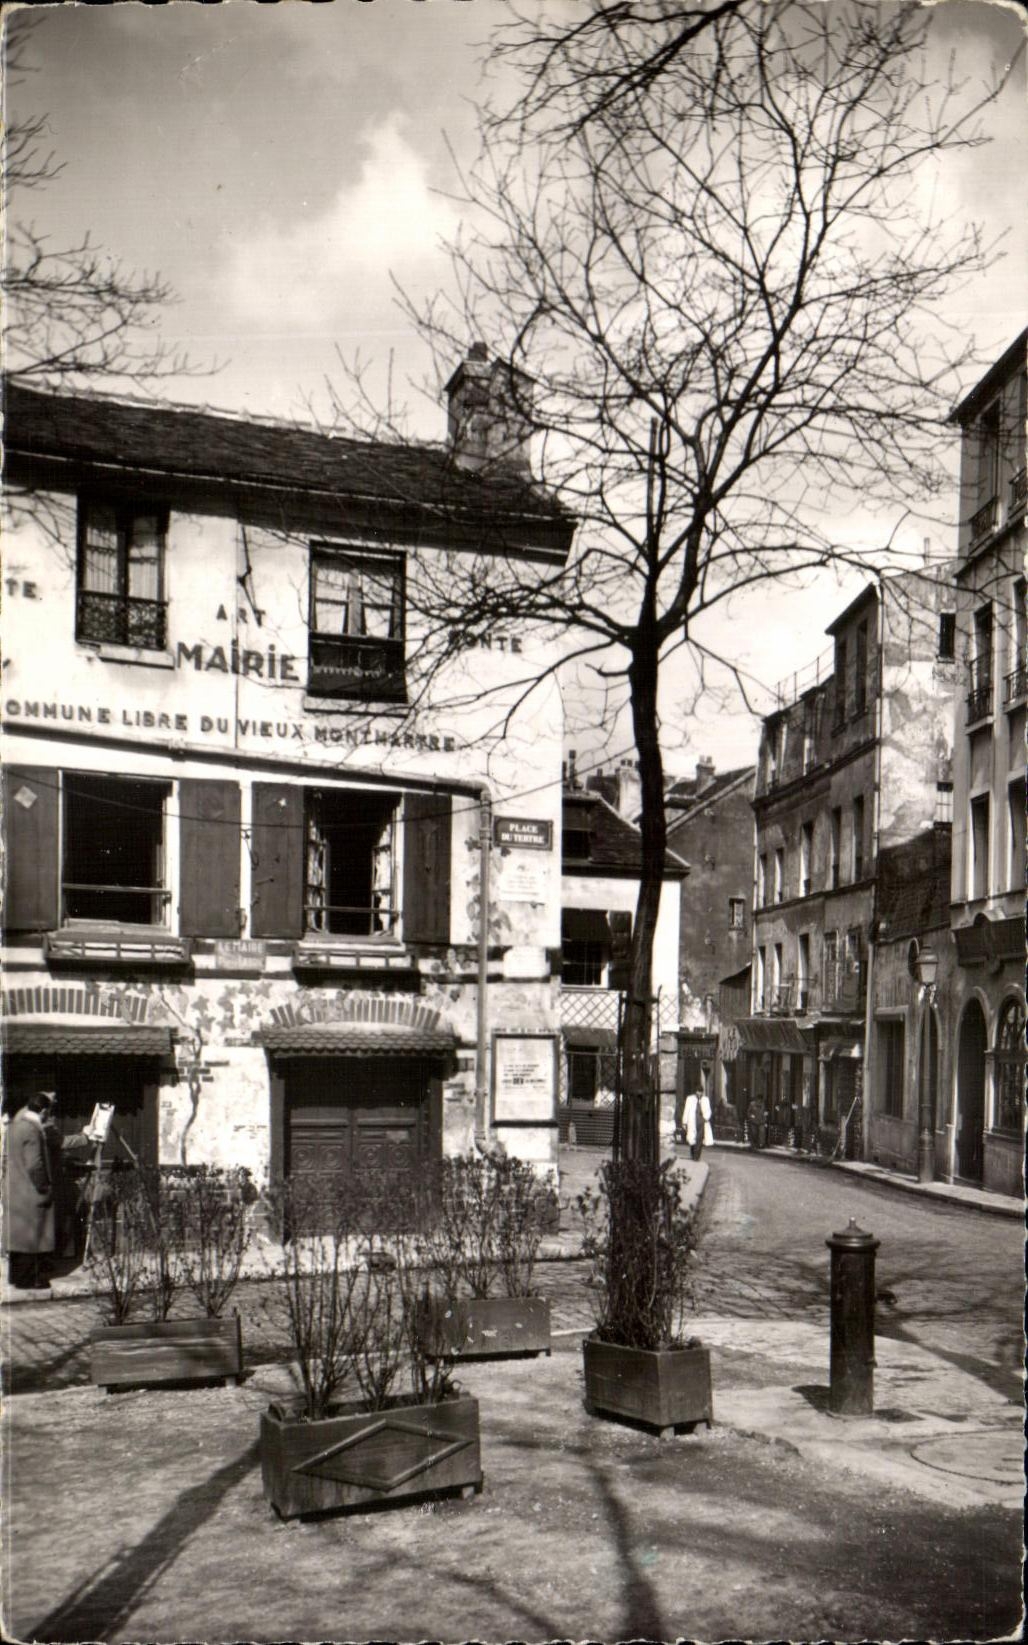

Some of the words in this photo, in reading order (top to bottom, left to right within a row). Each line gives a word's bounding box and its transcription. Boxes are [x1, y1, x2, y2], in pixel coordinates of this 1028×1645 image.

[216, 603, 266, 628] ART
[122, 709, 188, 731] LIBRE
[200, 715, 228, 734] DU
[238, 718, 303, 741] VIEUX
[509, 823, 538, 833] PLACE
[513, 834, 545, 844] TERTRE
